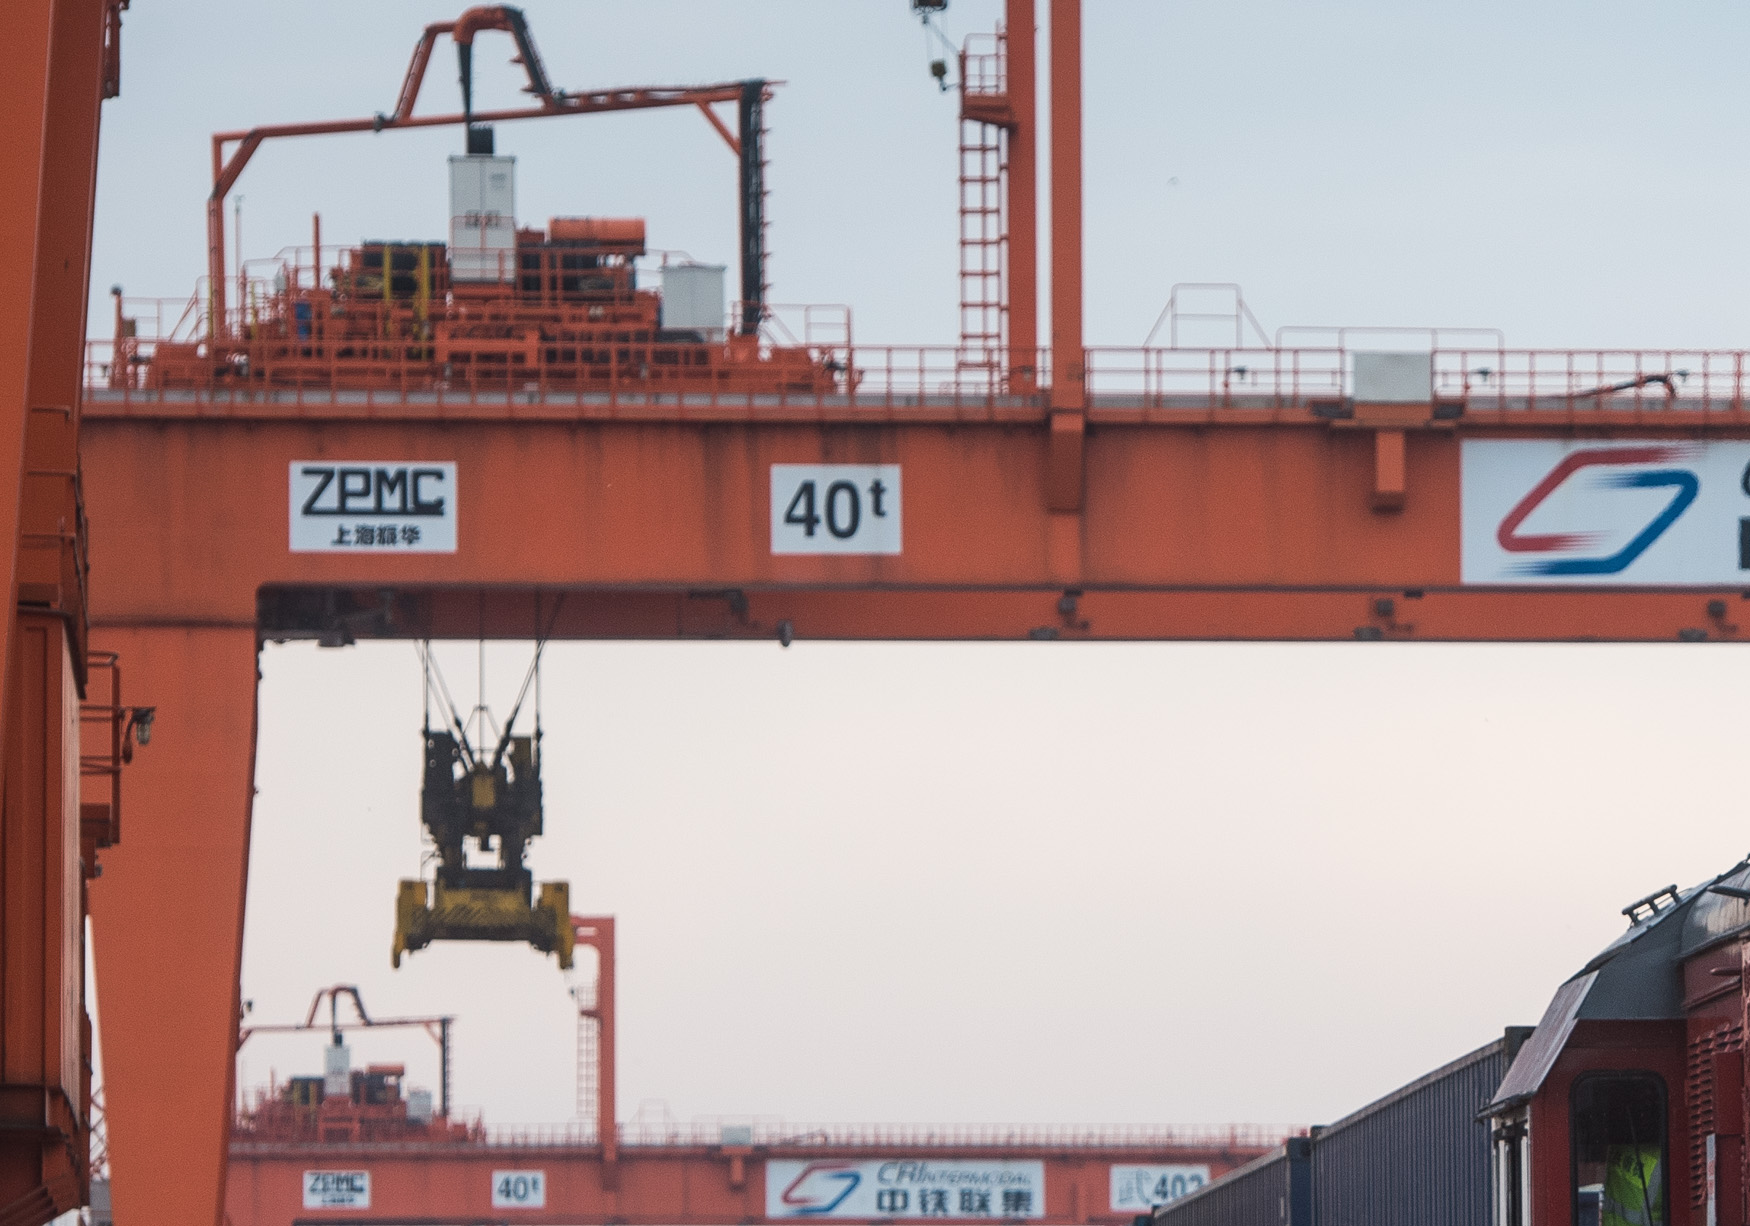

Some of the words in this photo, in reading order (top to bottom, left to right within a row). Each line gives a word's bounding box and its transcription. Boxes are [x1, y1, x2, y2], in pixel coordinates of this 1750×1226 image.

[302, 467, 444, 516] ZPMC
[783, 478, 887, 539] 40t
[331, 525, 421, 545] 上海振华
